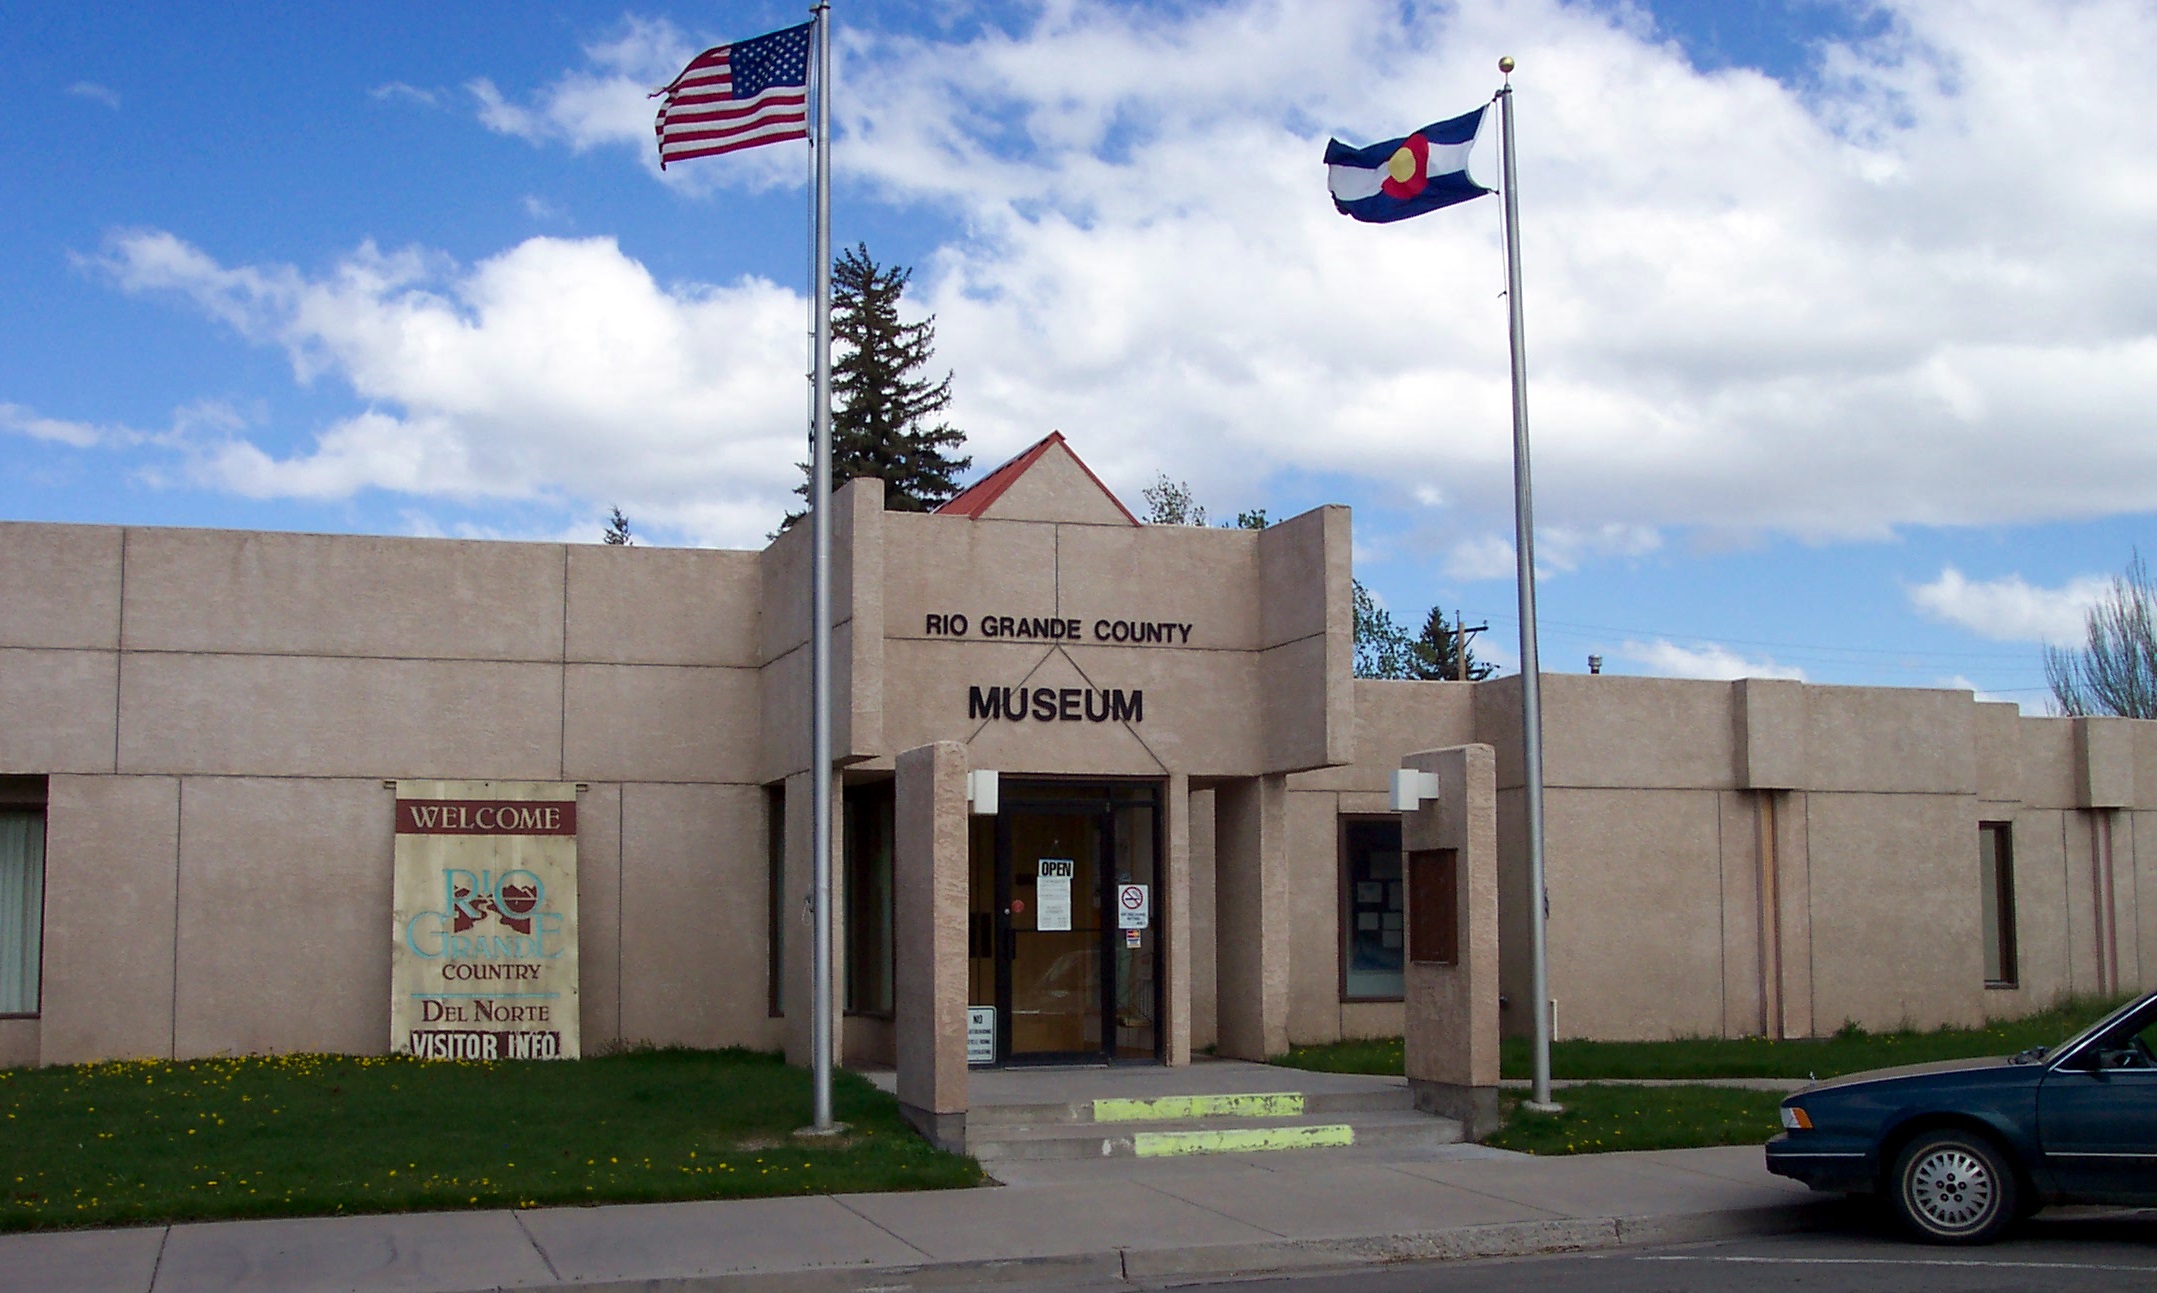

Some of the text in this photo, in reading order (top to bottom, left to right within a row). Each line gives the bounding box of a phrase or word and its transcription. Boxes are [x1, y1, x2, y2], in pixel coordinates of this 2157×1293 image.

[926, 614, 1193, 643] RIO GRANDE COUNTY
[968, 686, 1143, 722] MUSEUM
[410, 806, 561, 830] WELCOME
[1041, 861, 1071, 877] OPEN
[442, 869, 545, 919] RIO
[406, 911, 565, 960] GRANDE
[442, 963, 541, 981] COUNTRY
[473, 1000, 550, 1023] NORTE
[412, 1033, 498, 1060] VISITOR
